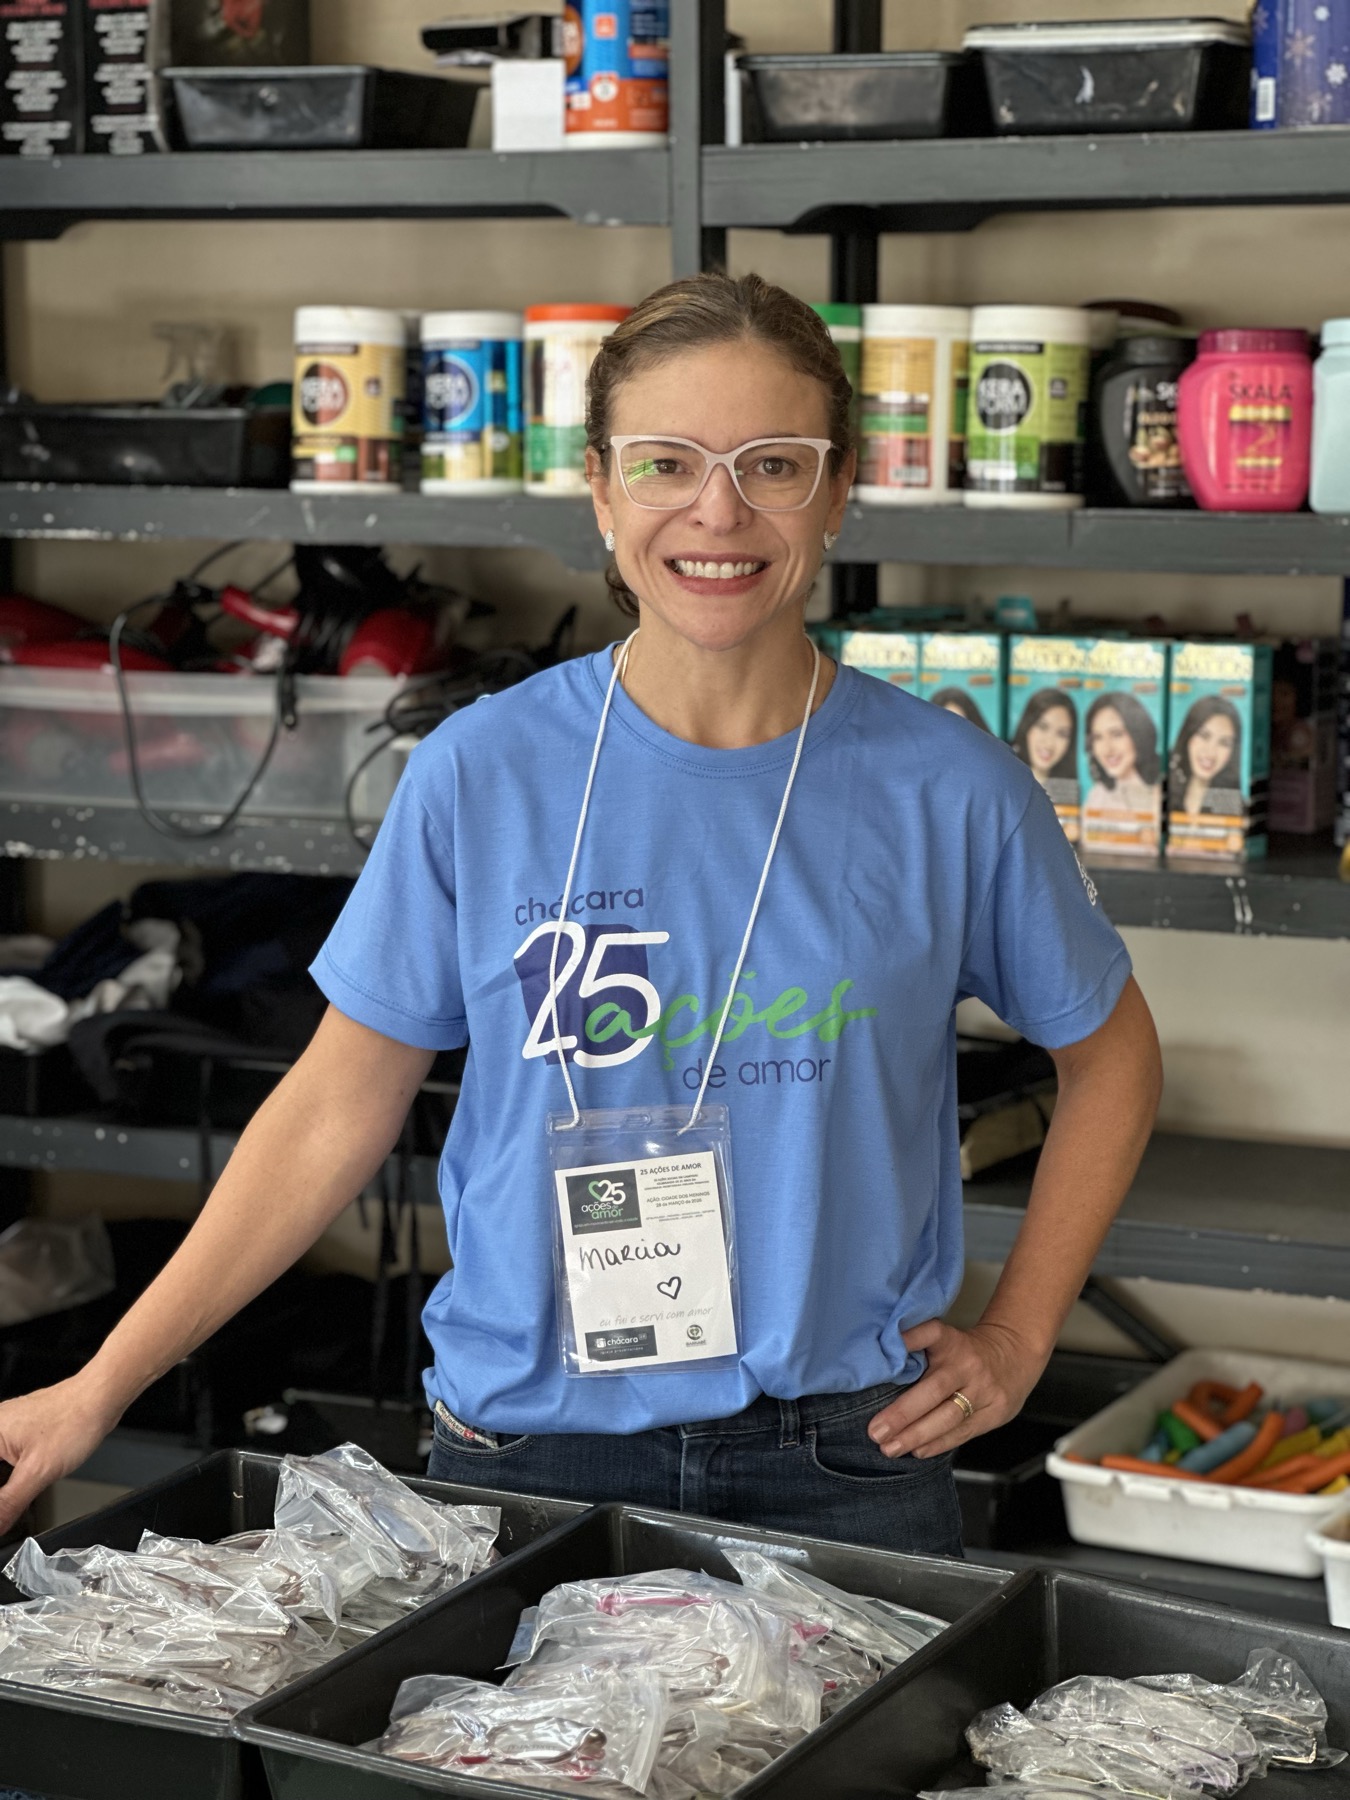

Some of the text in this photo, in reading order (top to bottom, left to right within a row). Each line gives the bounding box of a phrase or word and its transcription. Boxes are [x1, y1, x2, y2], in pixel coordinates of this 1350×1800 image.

[1230, 384, 1292, 401] SKALA
[514, 887, 645, 926] chácara
[513, 920, 670, 1069] 25
[585, 970, 879, 1071] ações
[682, 1057, 832, 1090] de amor
[649, 1166, 670, 1175] AÇÕES
[597, 1179, 626, 1205] 25
[581, 1201, 612, 1213] ações
[591, 1208, 623, 1220] amor
[599, 1306, 713, 1327] eu fui e servi com amor
